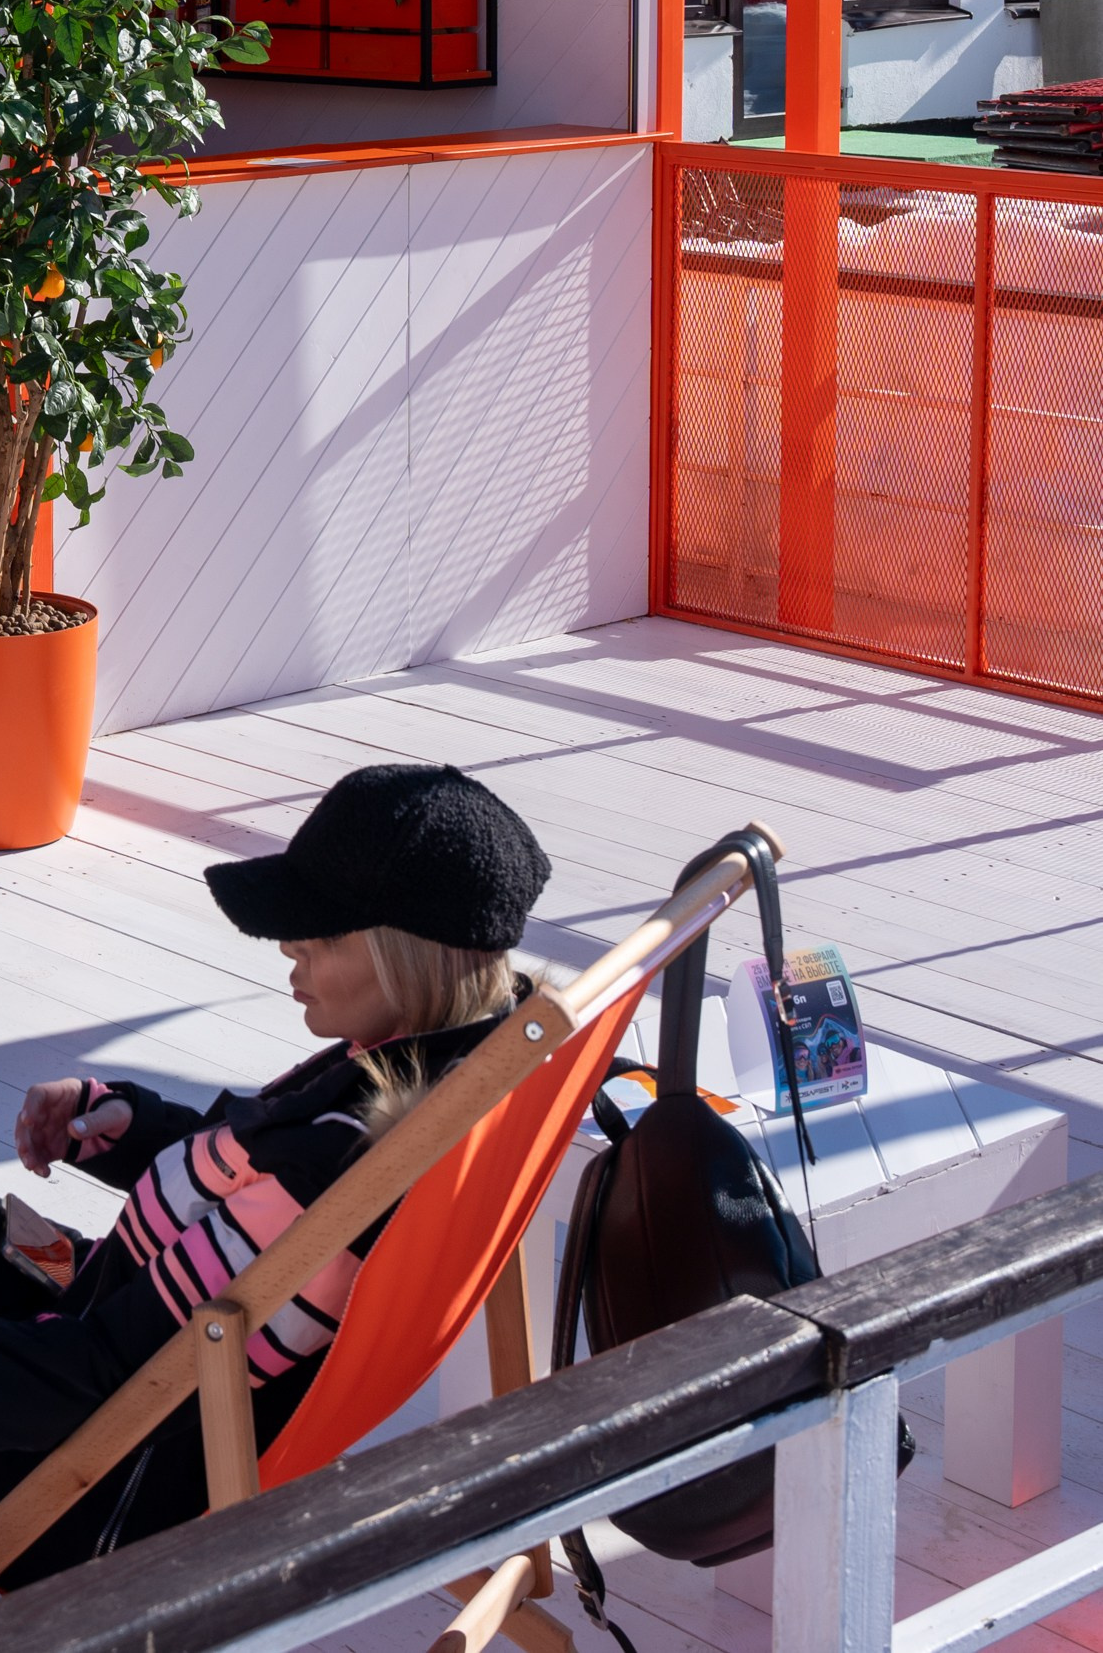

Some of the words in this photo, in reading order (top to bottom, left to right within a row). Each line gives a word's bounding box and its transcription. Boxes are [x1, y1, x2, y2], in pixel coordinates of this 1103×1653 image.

[752, 964, 763, 975] 25
[802, 949, 837, 964] ФЕВРАЛЯ
[792, 969, 805, 982] НА
[805, 961, 842, 978] ВЫСОТЕ
